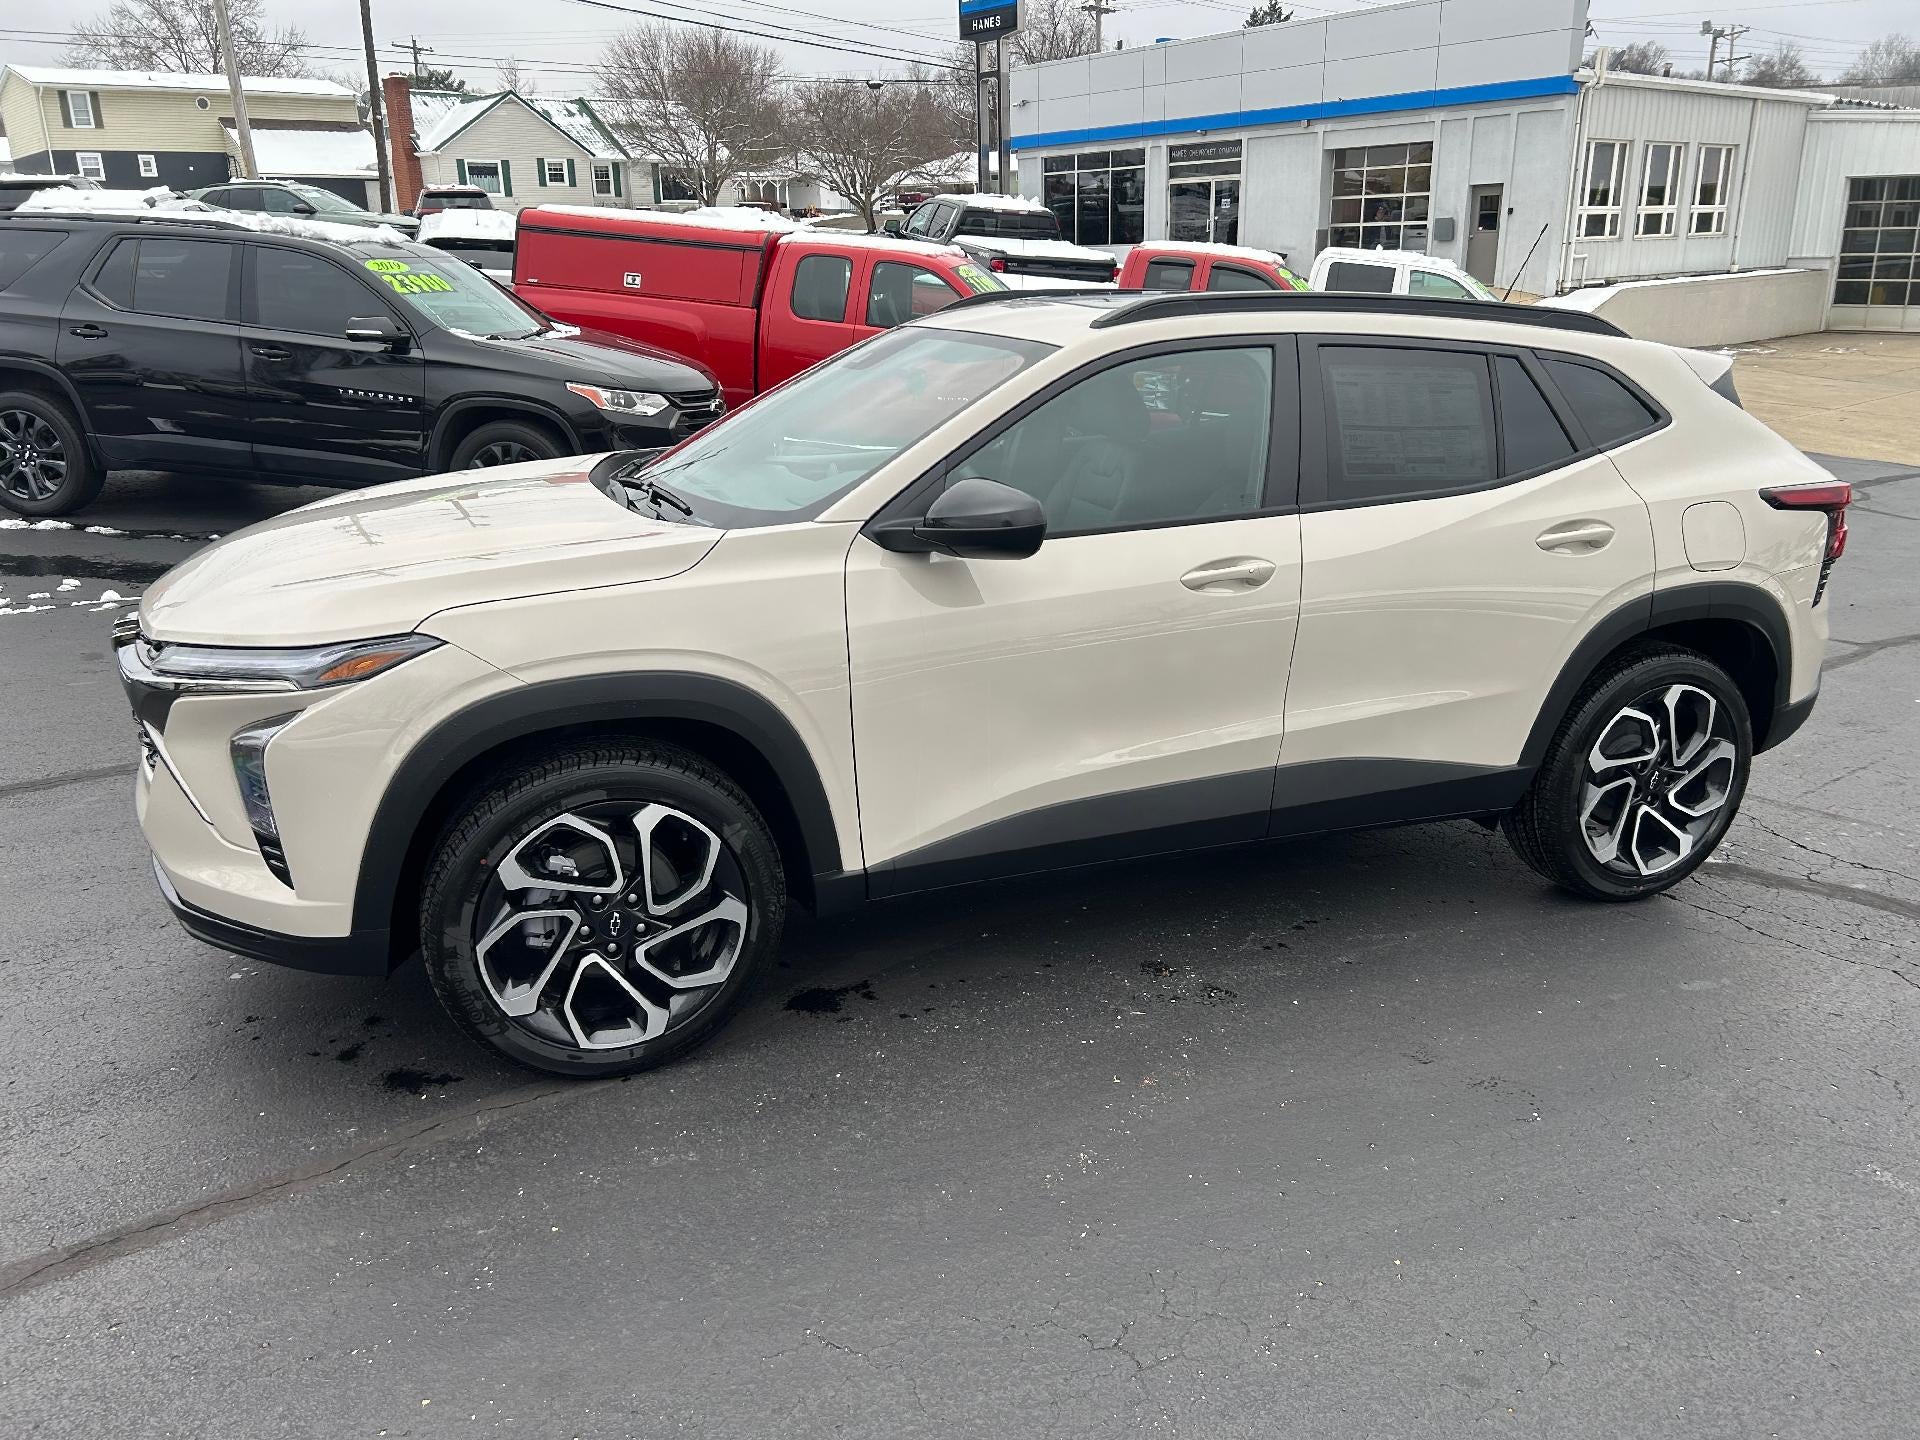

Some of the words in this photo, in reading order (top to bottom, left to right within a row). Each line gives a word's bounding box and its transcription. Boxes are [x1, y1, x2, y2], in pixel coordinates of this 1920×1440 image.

[972, 16, 1001, 31] HANES
[1172, 149, 1187, 158] HANES
[1189, 147, 1216, 157] CHEVROLET
[1218, 146, 1241, 155] COMPANY
[382, 273, 454, 293] 23900
